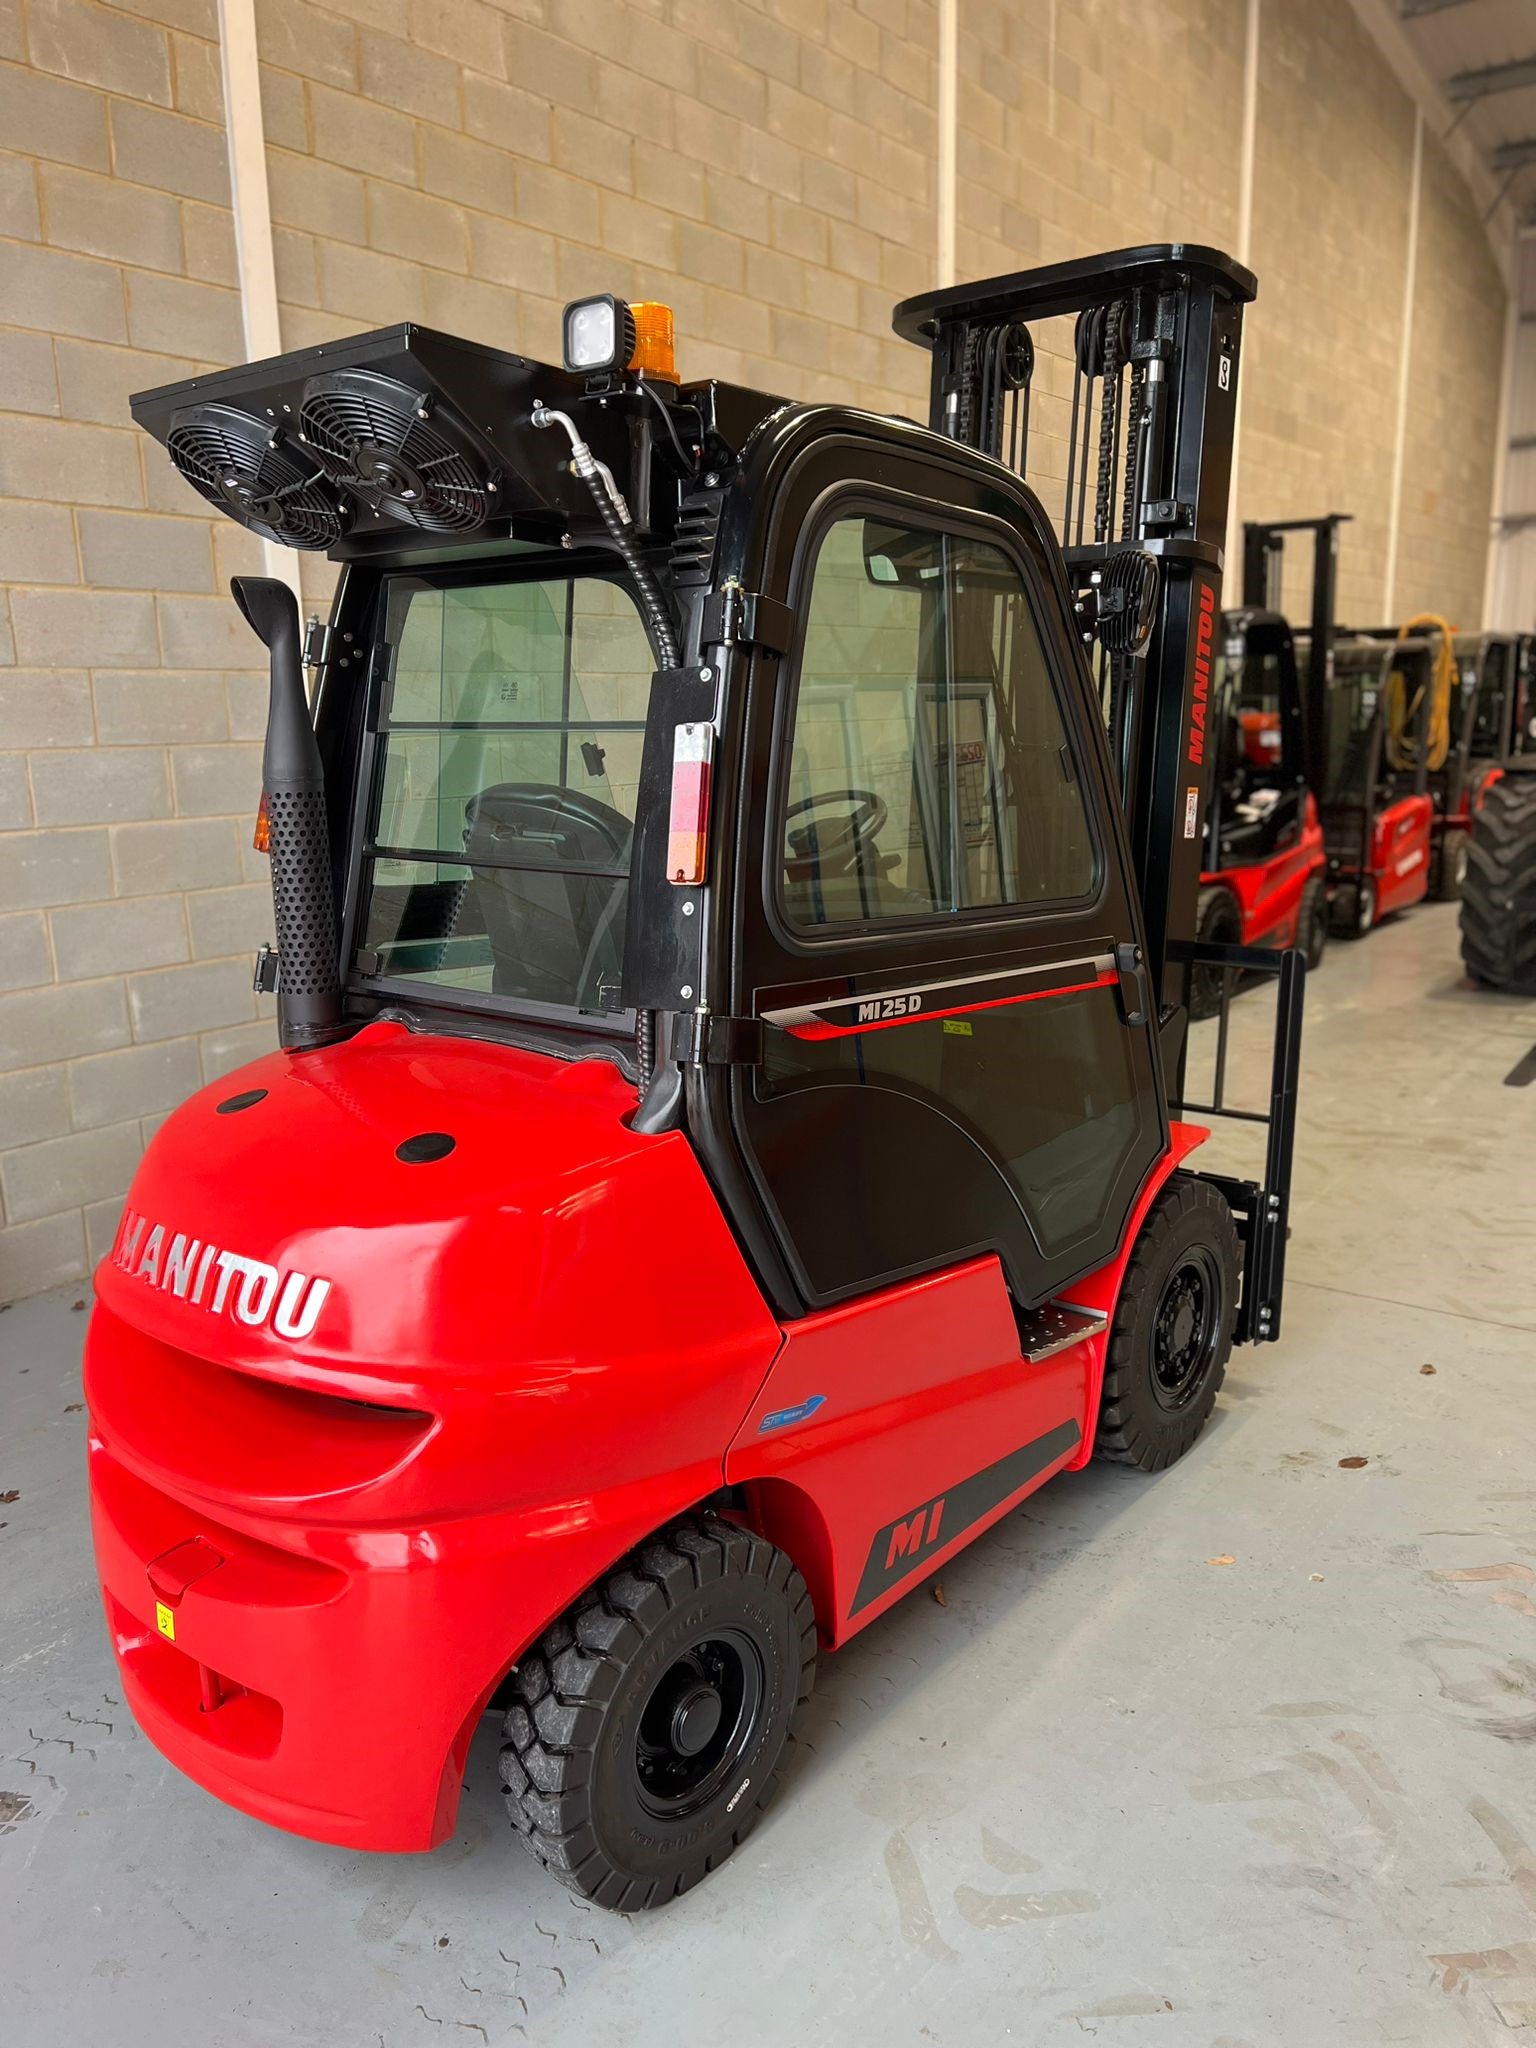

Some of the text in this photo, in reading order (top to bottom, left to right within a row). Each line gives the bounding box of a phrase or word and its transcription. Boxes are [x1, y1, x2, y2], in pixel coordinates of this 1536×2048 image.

[1188, 583, 1215, 765] MANITOU
[113, 1209, 331, 1339] MANITOU
[884, 1498, 946, 1570] MI
